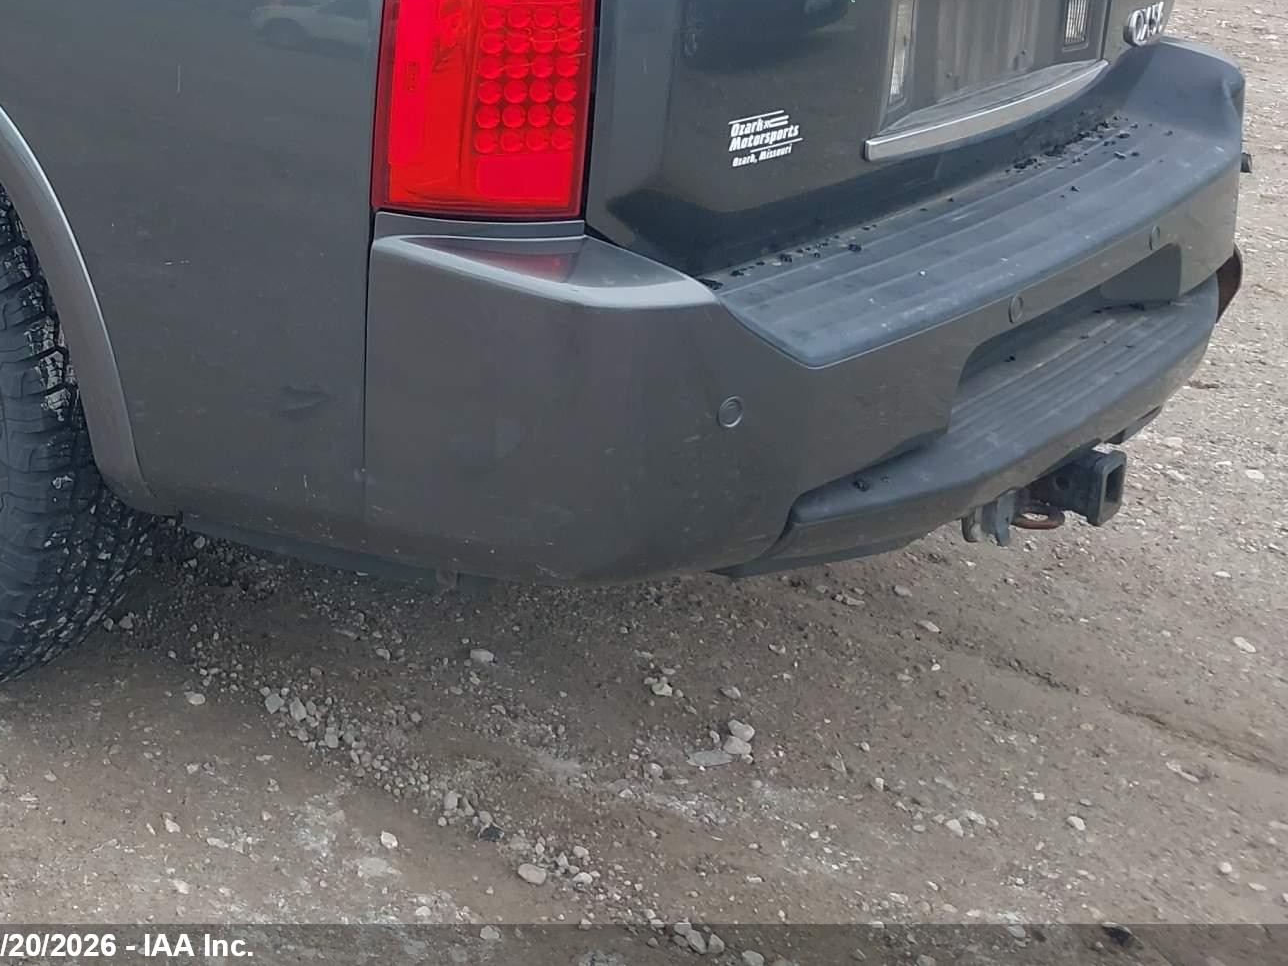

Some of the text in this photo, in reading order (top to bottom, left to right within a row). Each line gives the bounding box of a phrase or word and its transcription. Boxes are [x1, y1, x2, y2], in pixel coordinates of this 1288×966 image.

[730, 118, 765, 137] Ozark
[728, 124, 800, 152] Motorsports
[758, 144, 793, 161] Missouri
